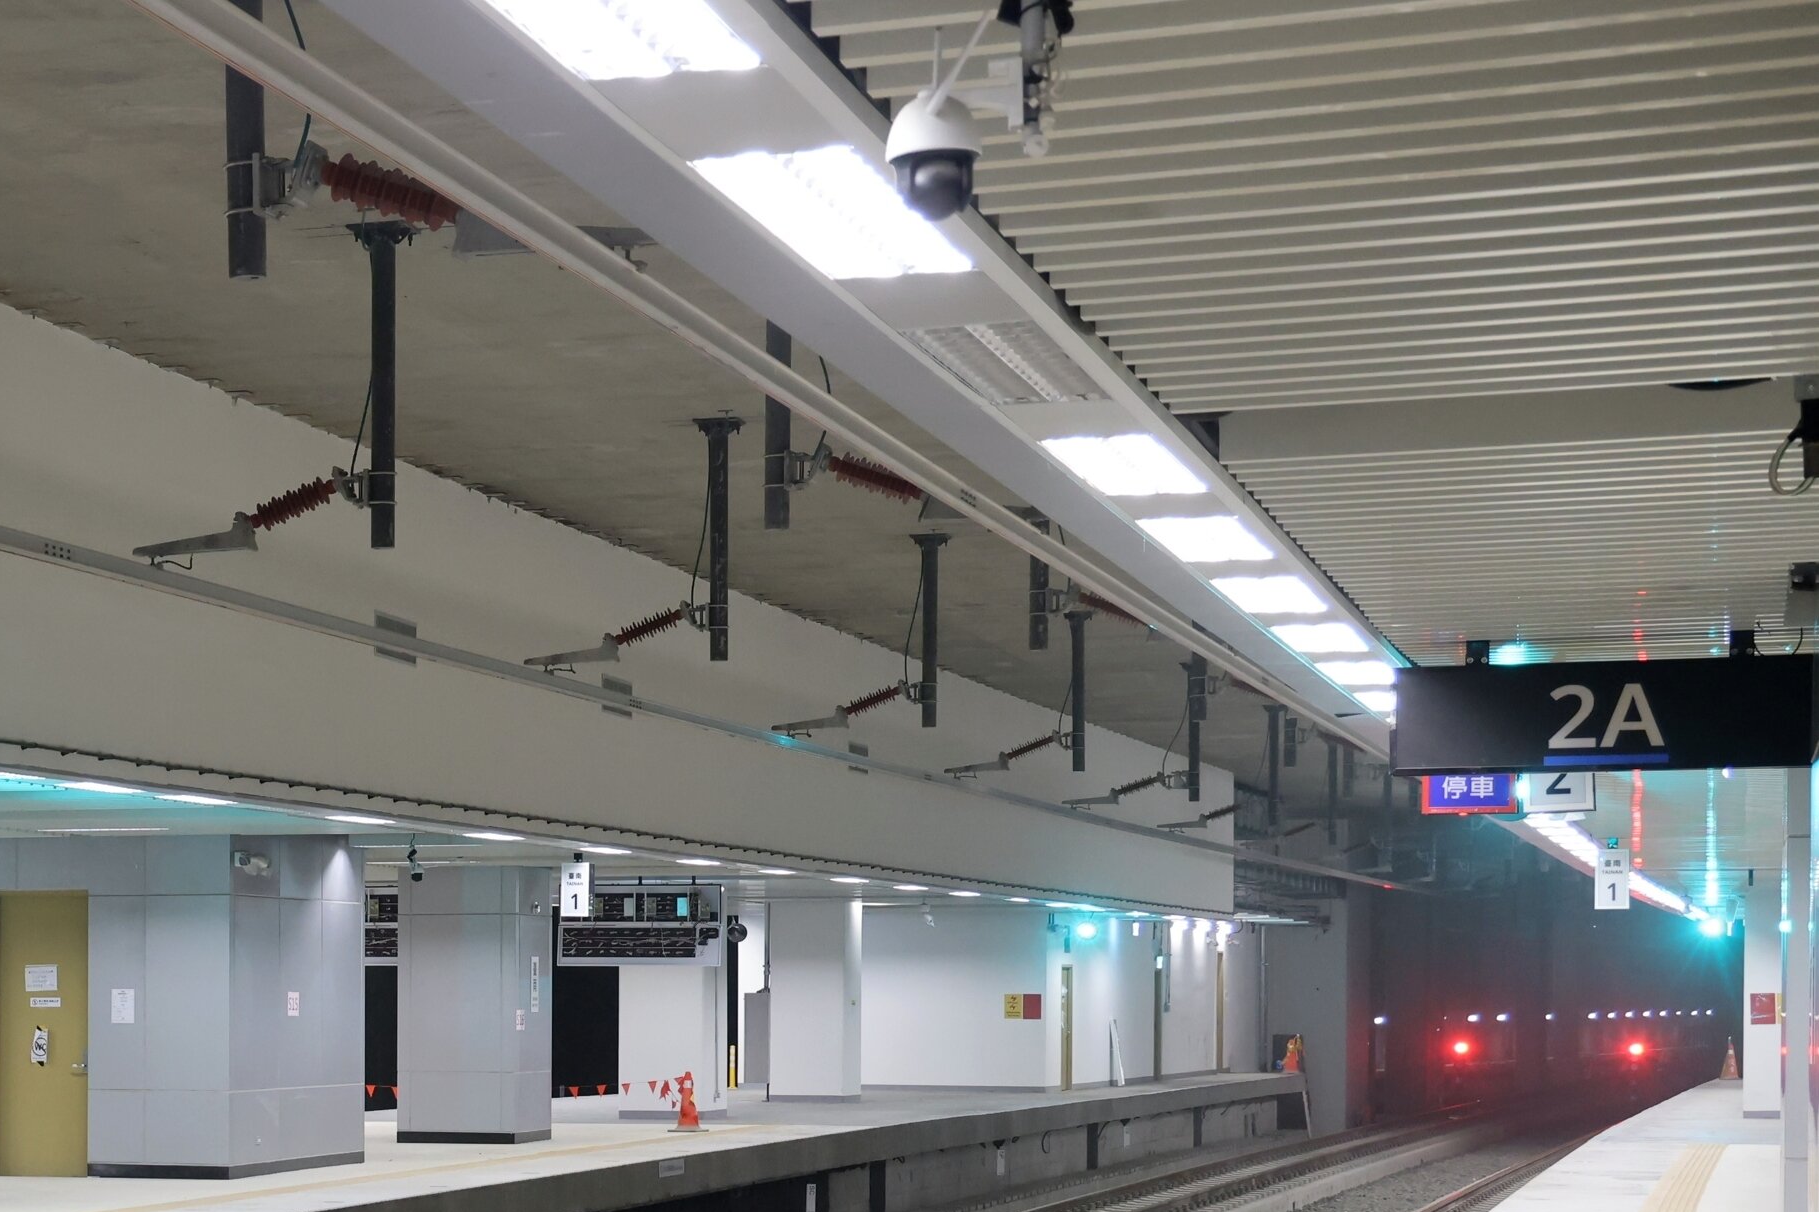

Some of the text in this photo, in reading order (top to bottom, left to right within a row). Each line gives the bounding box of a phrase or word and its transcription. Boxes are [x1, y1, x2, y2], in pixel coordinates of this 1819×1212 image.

[1548, 682, 1665, 749] 2A
[1441, 776, 1495, 800] 停車
[571, 893, 578, 910] 1
[1607, 883, 1616, 901] 1
